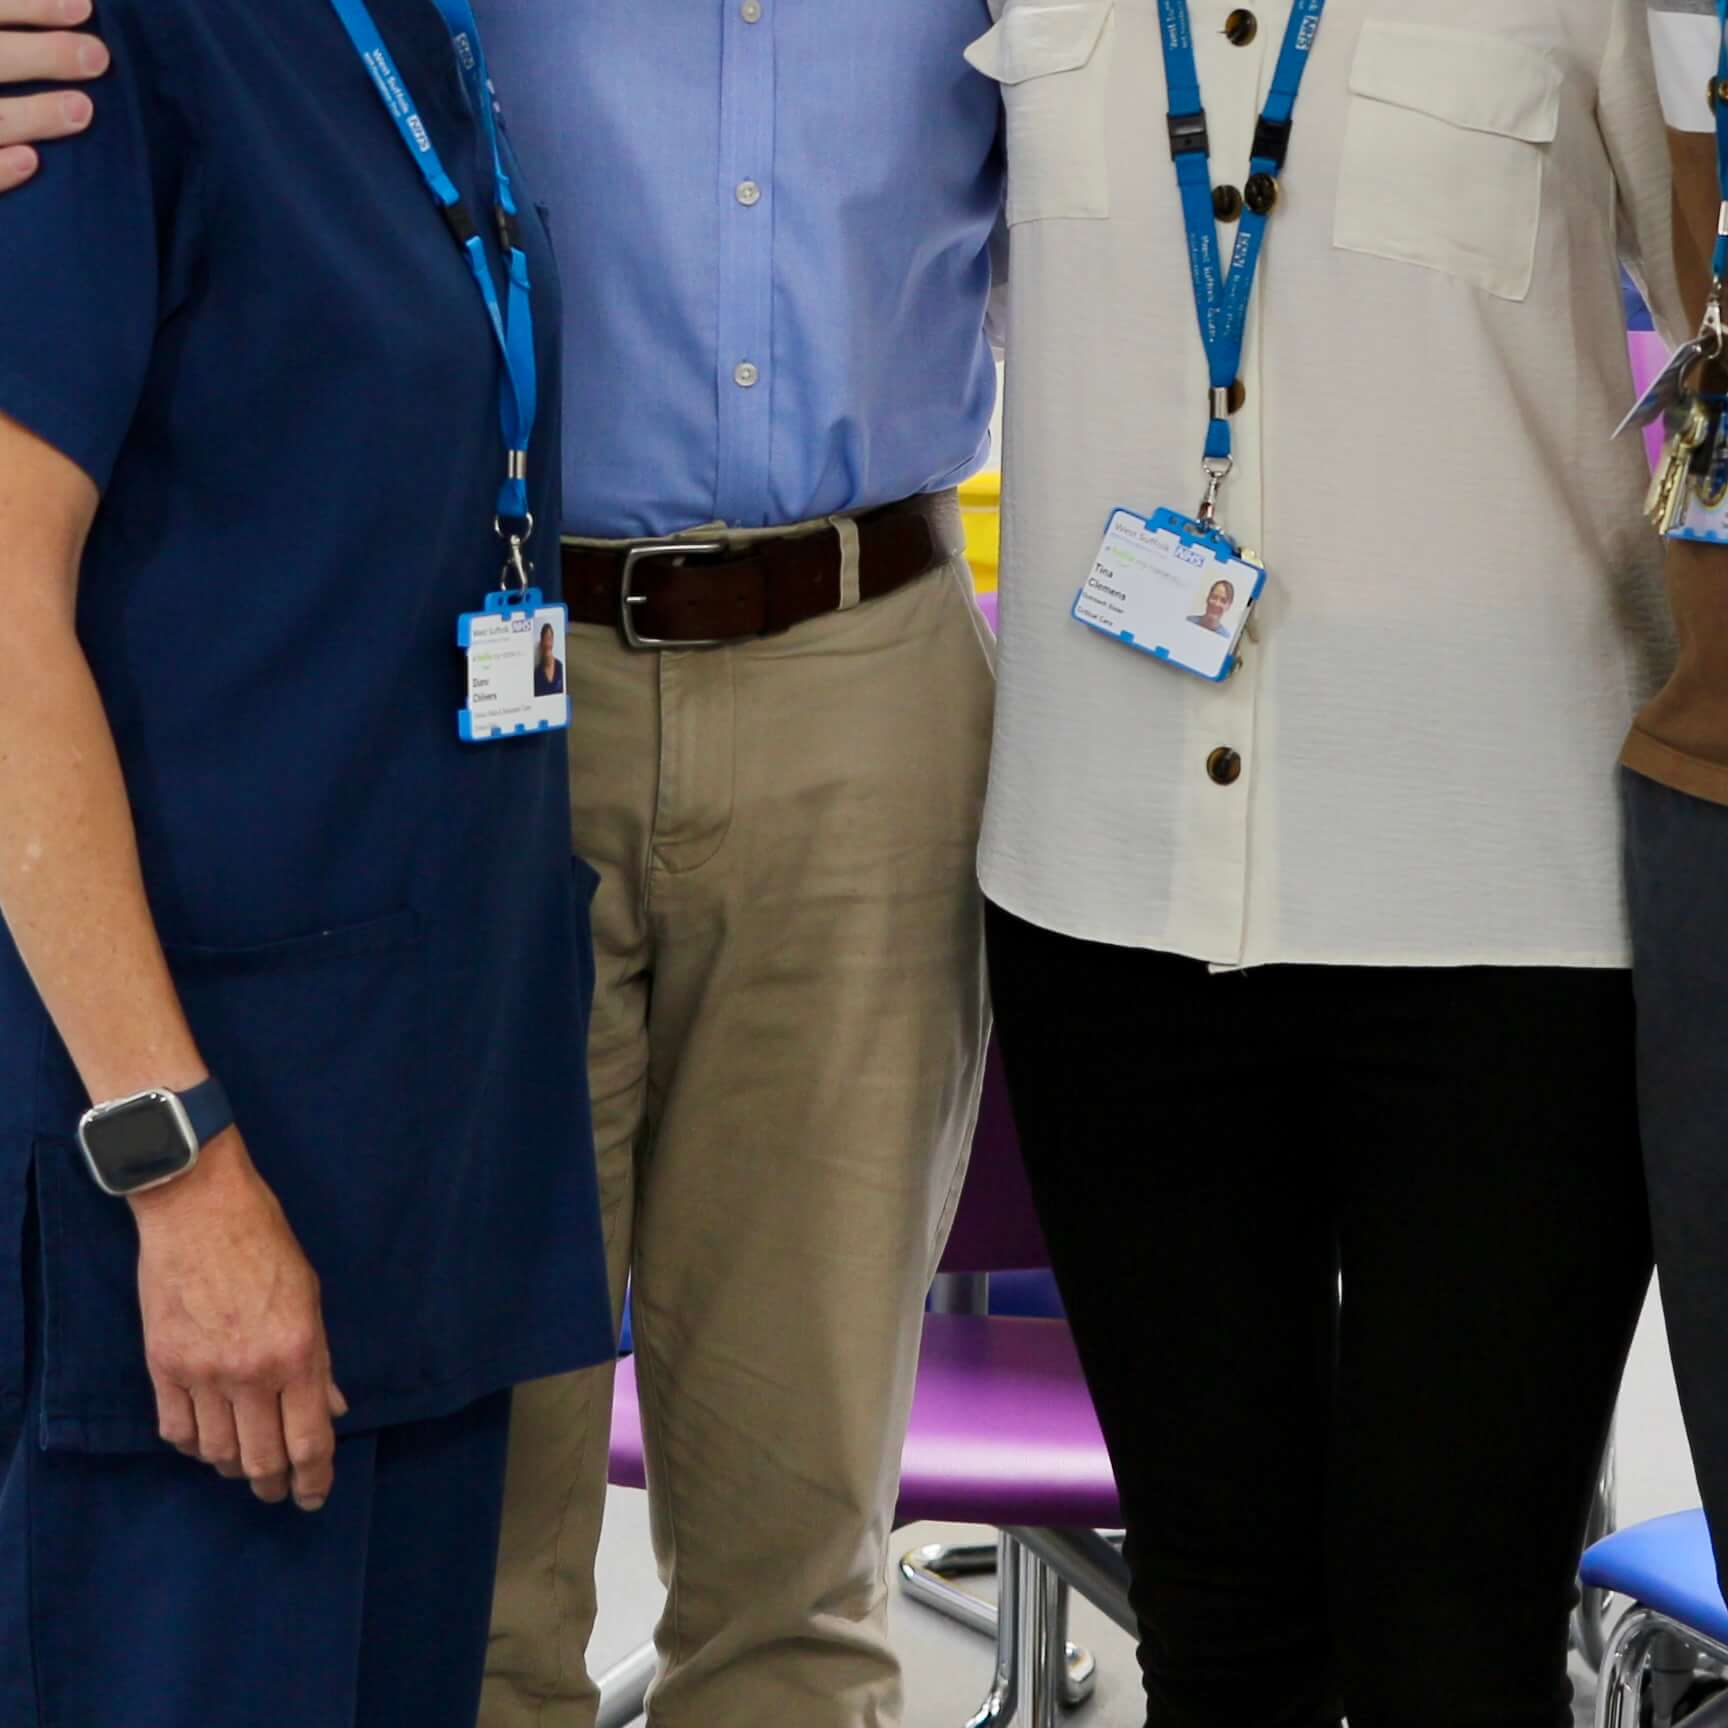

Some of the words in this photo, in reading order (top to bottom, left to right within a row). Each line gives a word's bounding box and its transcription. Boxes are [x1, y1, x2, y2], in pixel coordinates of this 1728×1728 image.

[373, 48, 390, 76] West
[387, 76, 409, 114] Suffolk
[406, 114, 431, 152] NHS
[1095, 562, 1114, 578] Tina
